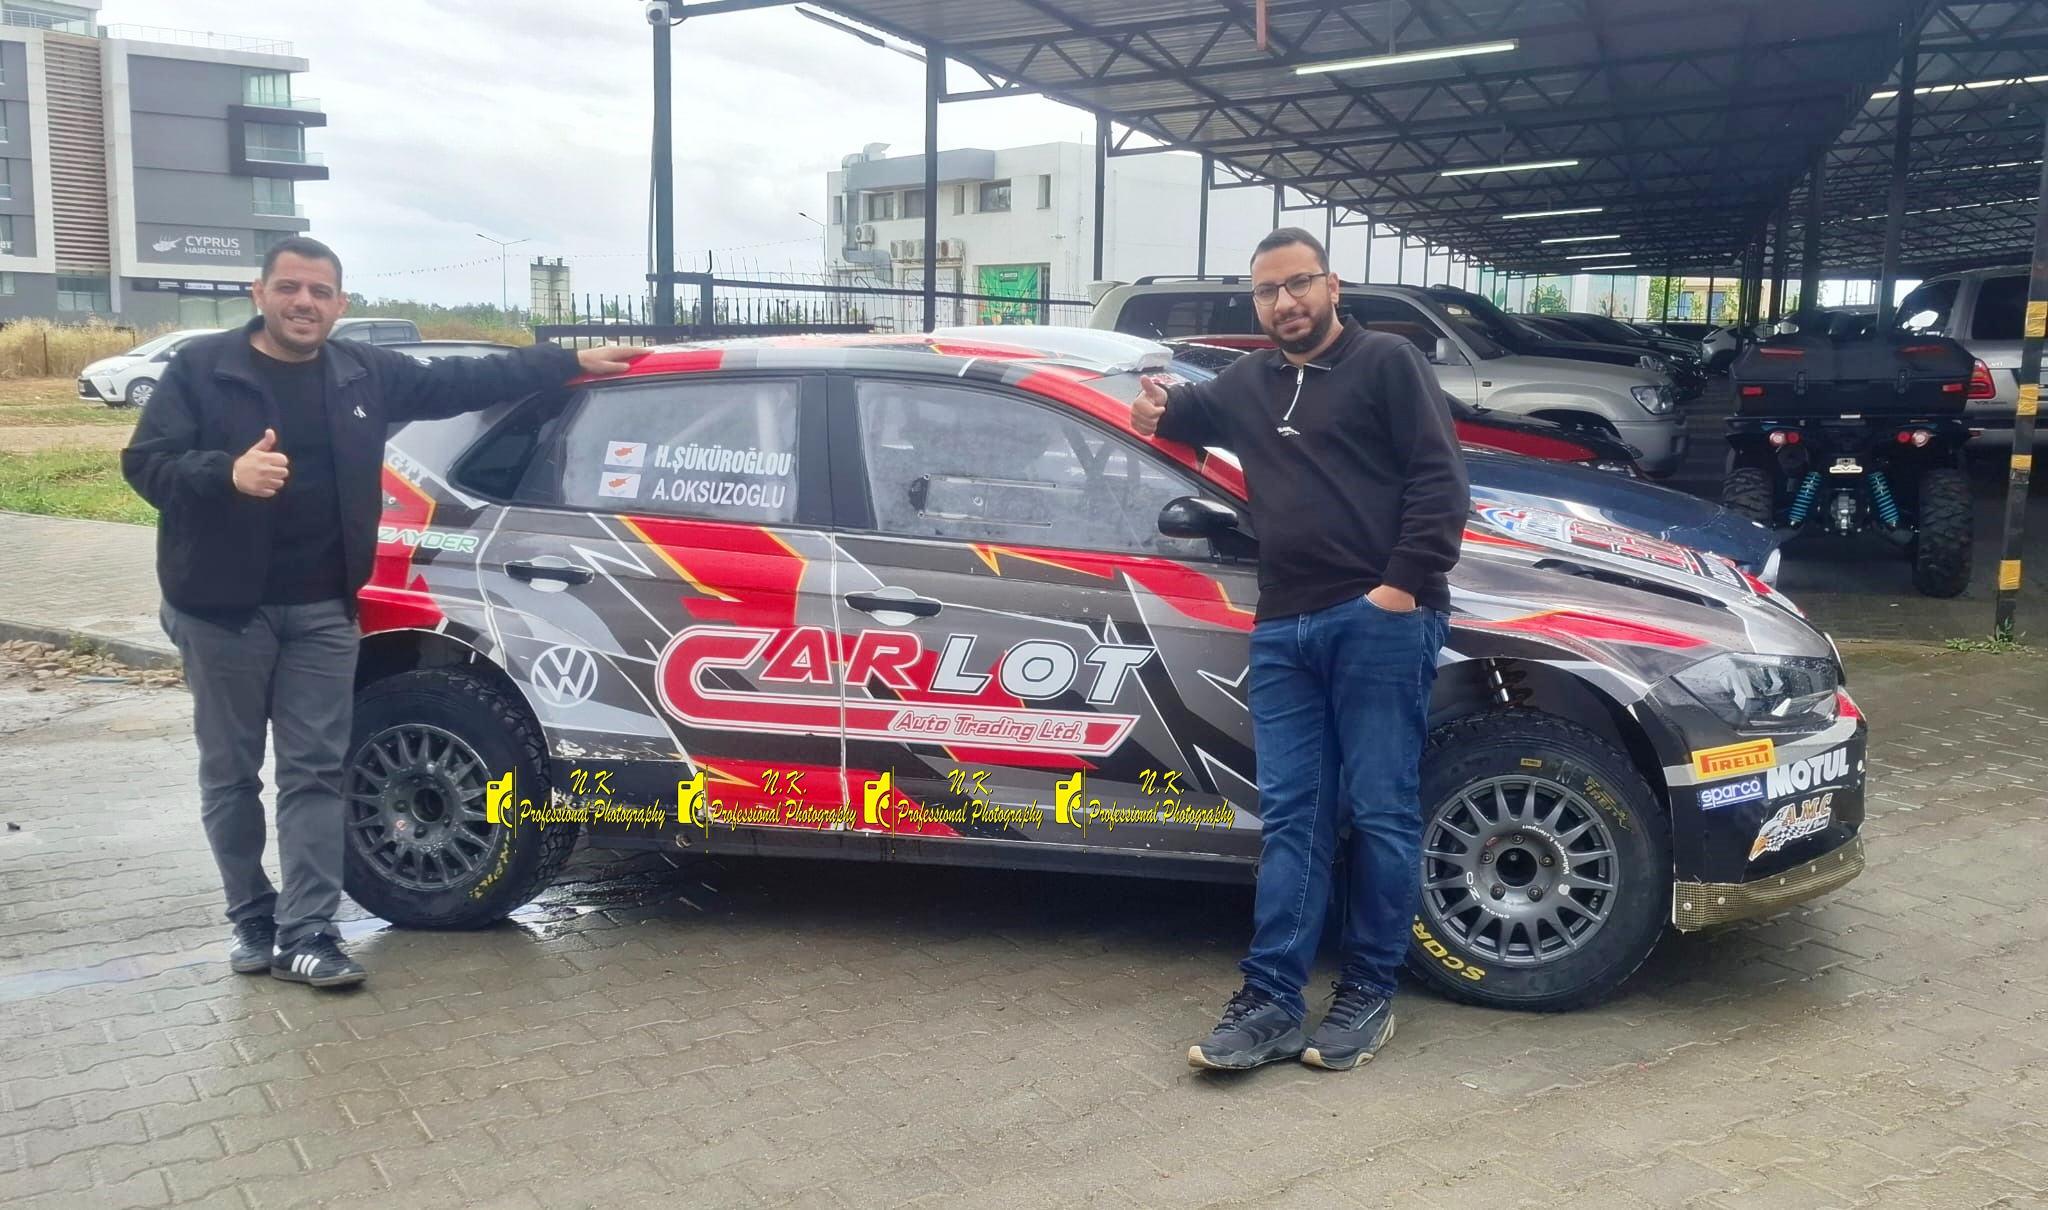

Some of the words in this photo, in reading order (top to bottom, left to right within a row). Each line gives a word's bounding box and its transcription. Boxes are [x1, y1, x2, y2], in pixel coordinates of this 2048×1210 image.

[184, 246, 207, 255] HAIR
[207, 248, 241, 257] CENTER
[185, 235, 240, 249] CYPRUS
[654, 443, 792, 477] H.ŞÜKÜROĞLOU
[652, 478, 786, 509] A.OKSUZOGLU
[378, 526, 479, 553] ZAYDER
[655, 624, 1155, 735] CARLOT
[896, 712, 950, 733] Auto
[955, 715, 1035, 741] Trading
[1039, 720, 1082, 741] Ltd.
[1700, 744, 1770, 774] PIRELLI
[1766, 747, 1850, 800] MOTUL
[1700, 780, 1762, 810] sparco
[1411, 914, 1486, 981] SCOR
